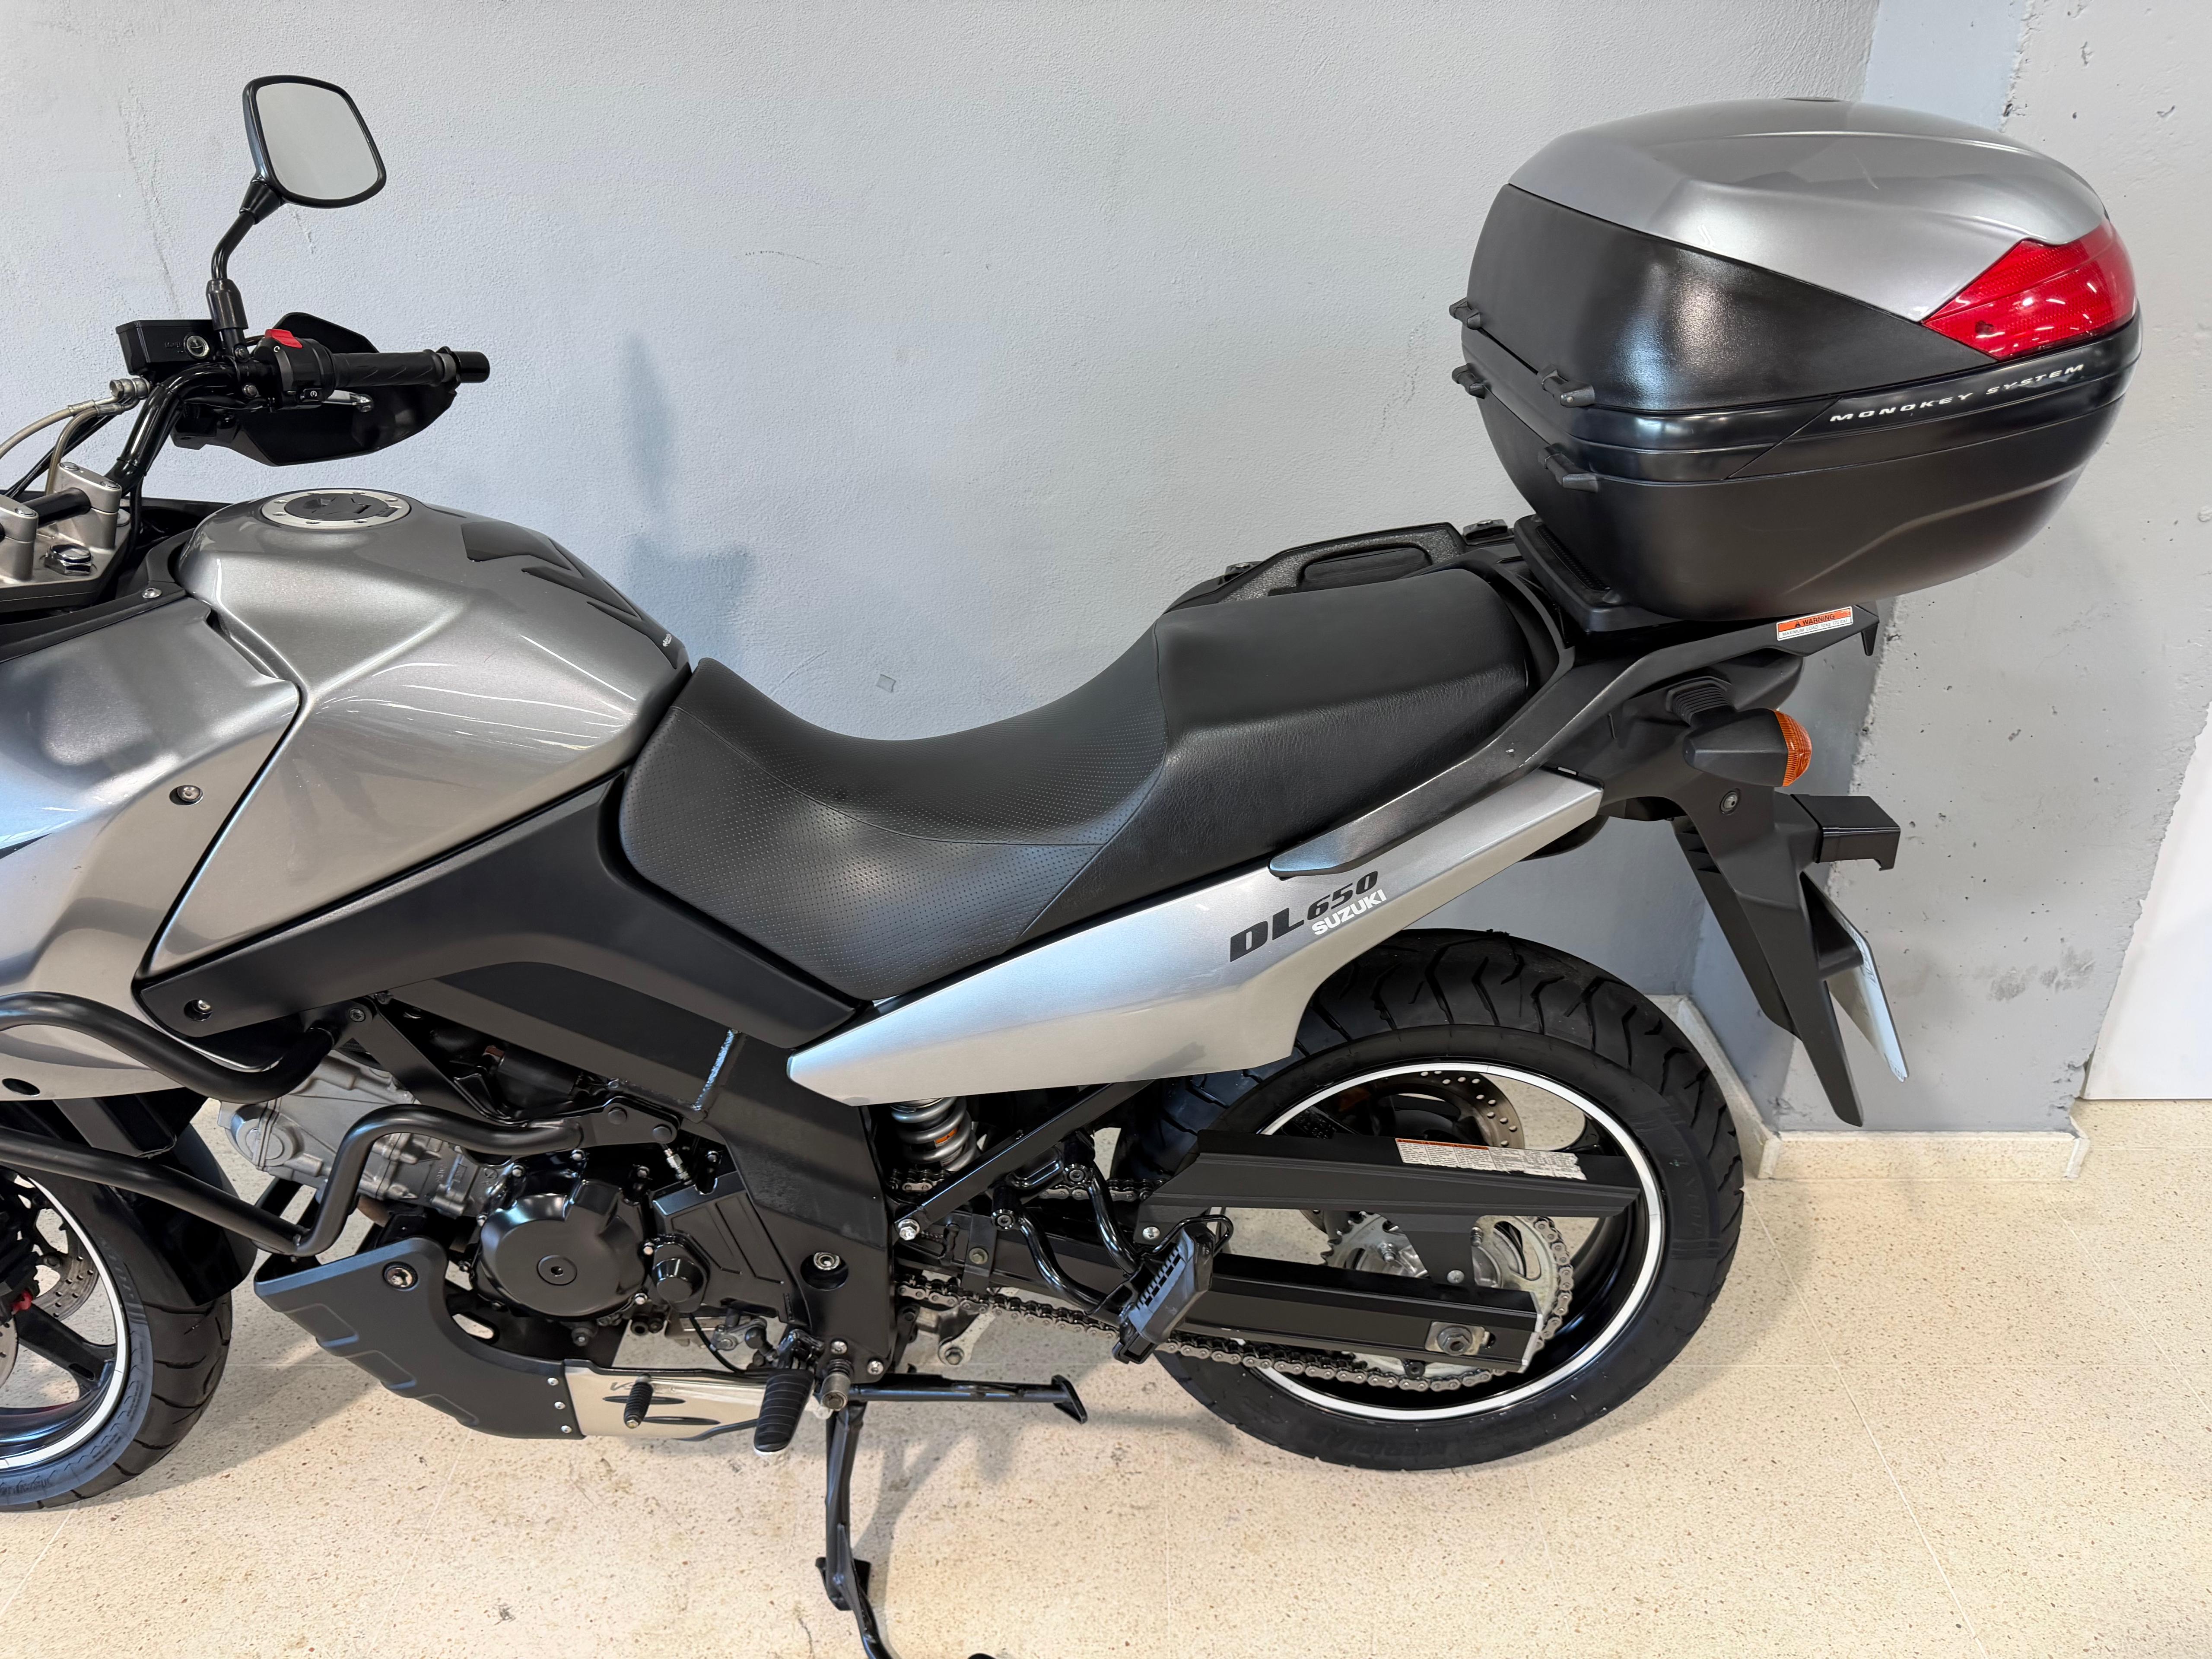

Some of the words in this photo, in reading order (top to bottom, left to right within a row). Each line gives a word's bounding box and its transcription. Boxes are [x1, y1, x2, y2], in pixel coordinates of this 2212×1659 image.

[1830, 392, 1973, 422] MONOKEY
[1986, 364, 2084, 394] SYSTEM
[1803, 614, 1835, 625] WARNING
[1312, 889, 1387, 935] SUZUKI
